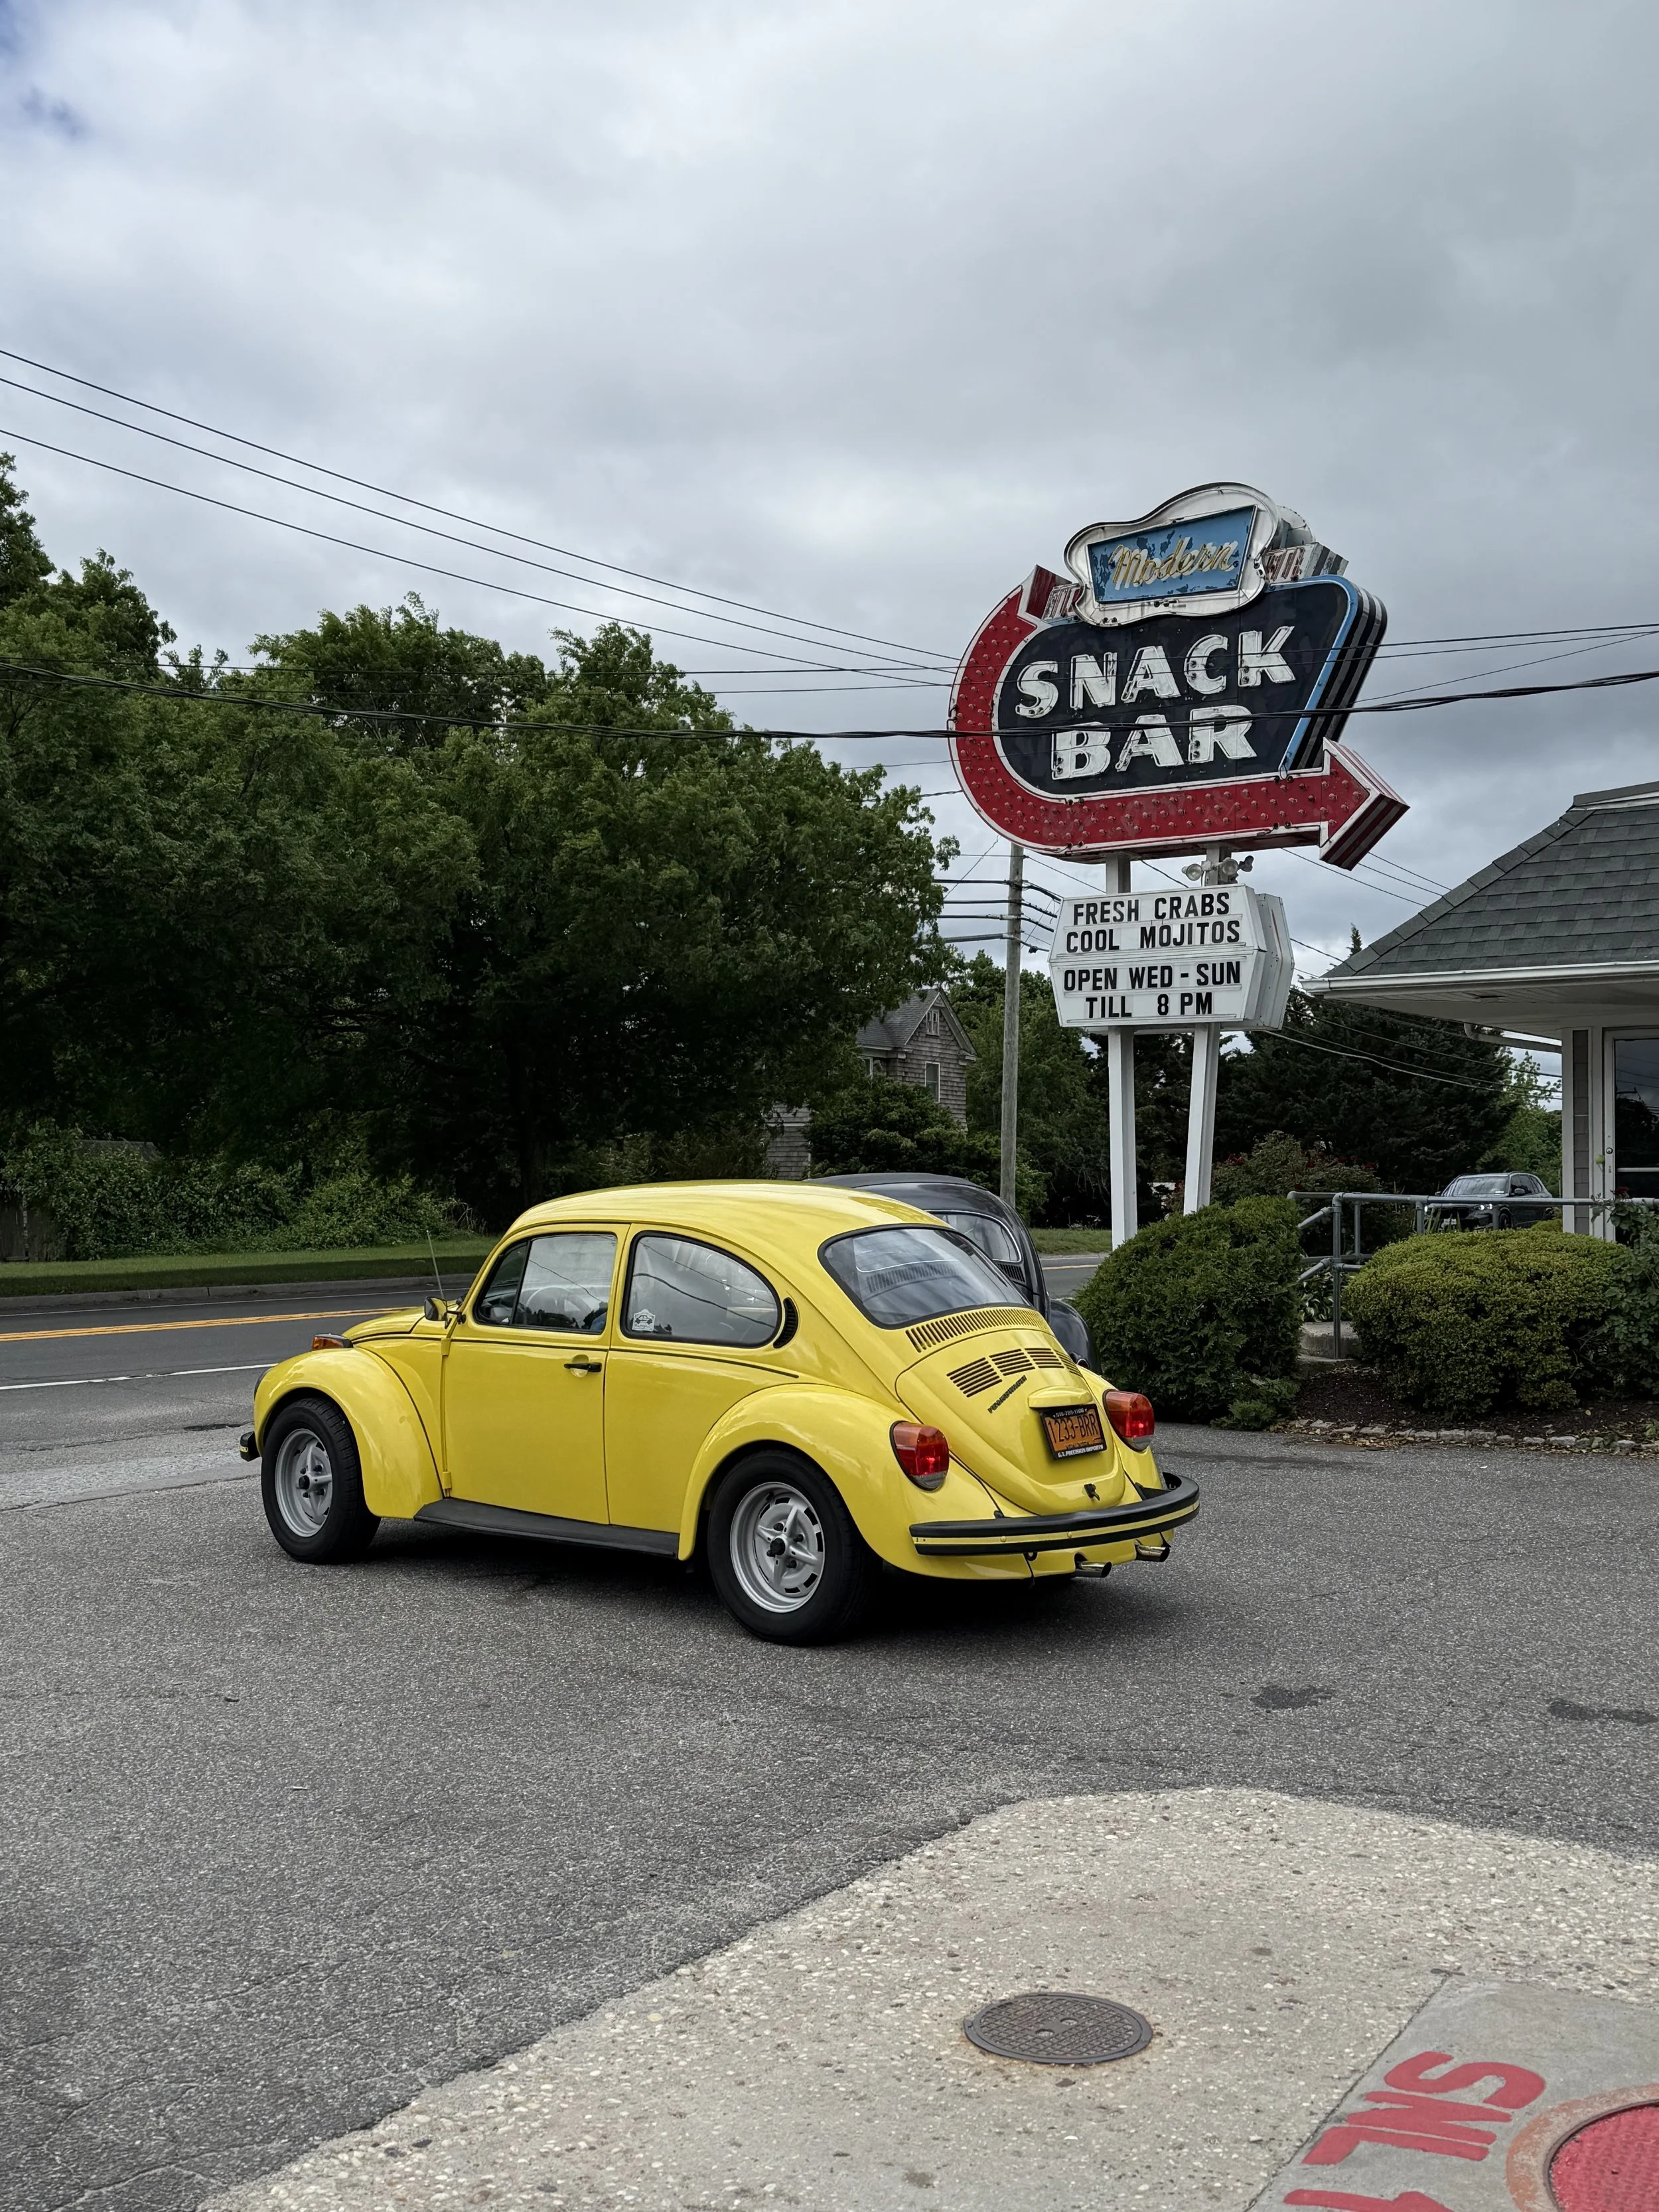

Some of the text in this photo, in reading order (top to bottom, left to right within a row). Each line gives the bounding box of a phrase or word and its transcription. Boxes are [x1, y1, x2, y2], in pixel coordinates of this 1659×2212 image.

[1109, 536, 1238, 590] Modern
[1015, 626, 1296, 718] SNACK
[1051, 705, 1257, 780] BAR
[1073, 892, 1230, 926] FRESH CRABS
[1066, 920, 1240, 953] COOL MOJITOS
[1064, 968, 1118, 992] OPEN
[1085, 992, 1212, 1019] TILL 8 PM
[1048, 1413, 1099, 1443] 1233-BRR
[1302, 2051, 1546, 2164] SNL
